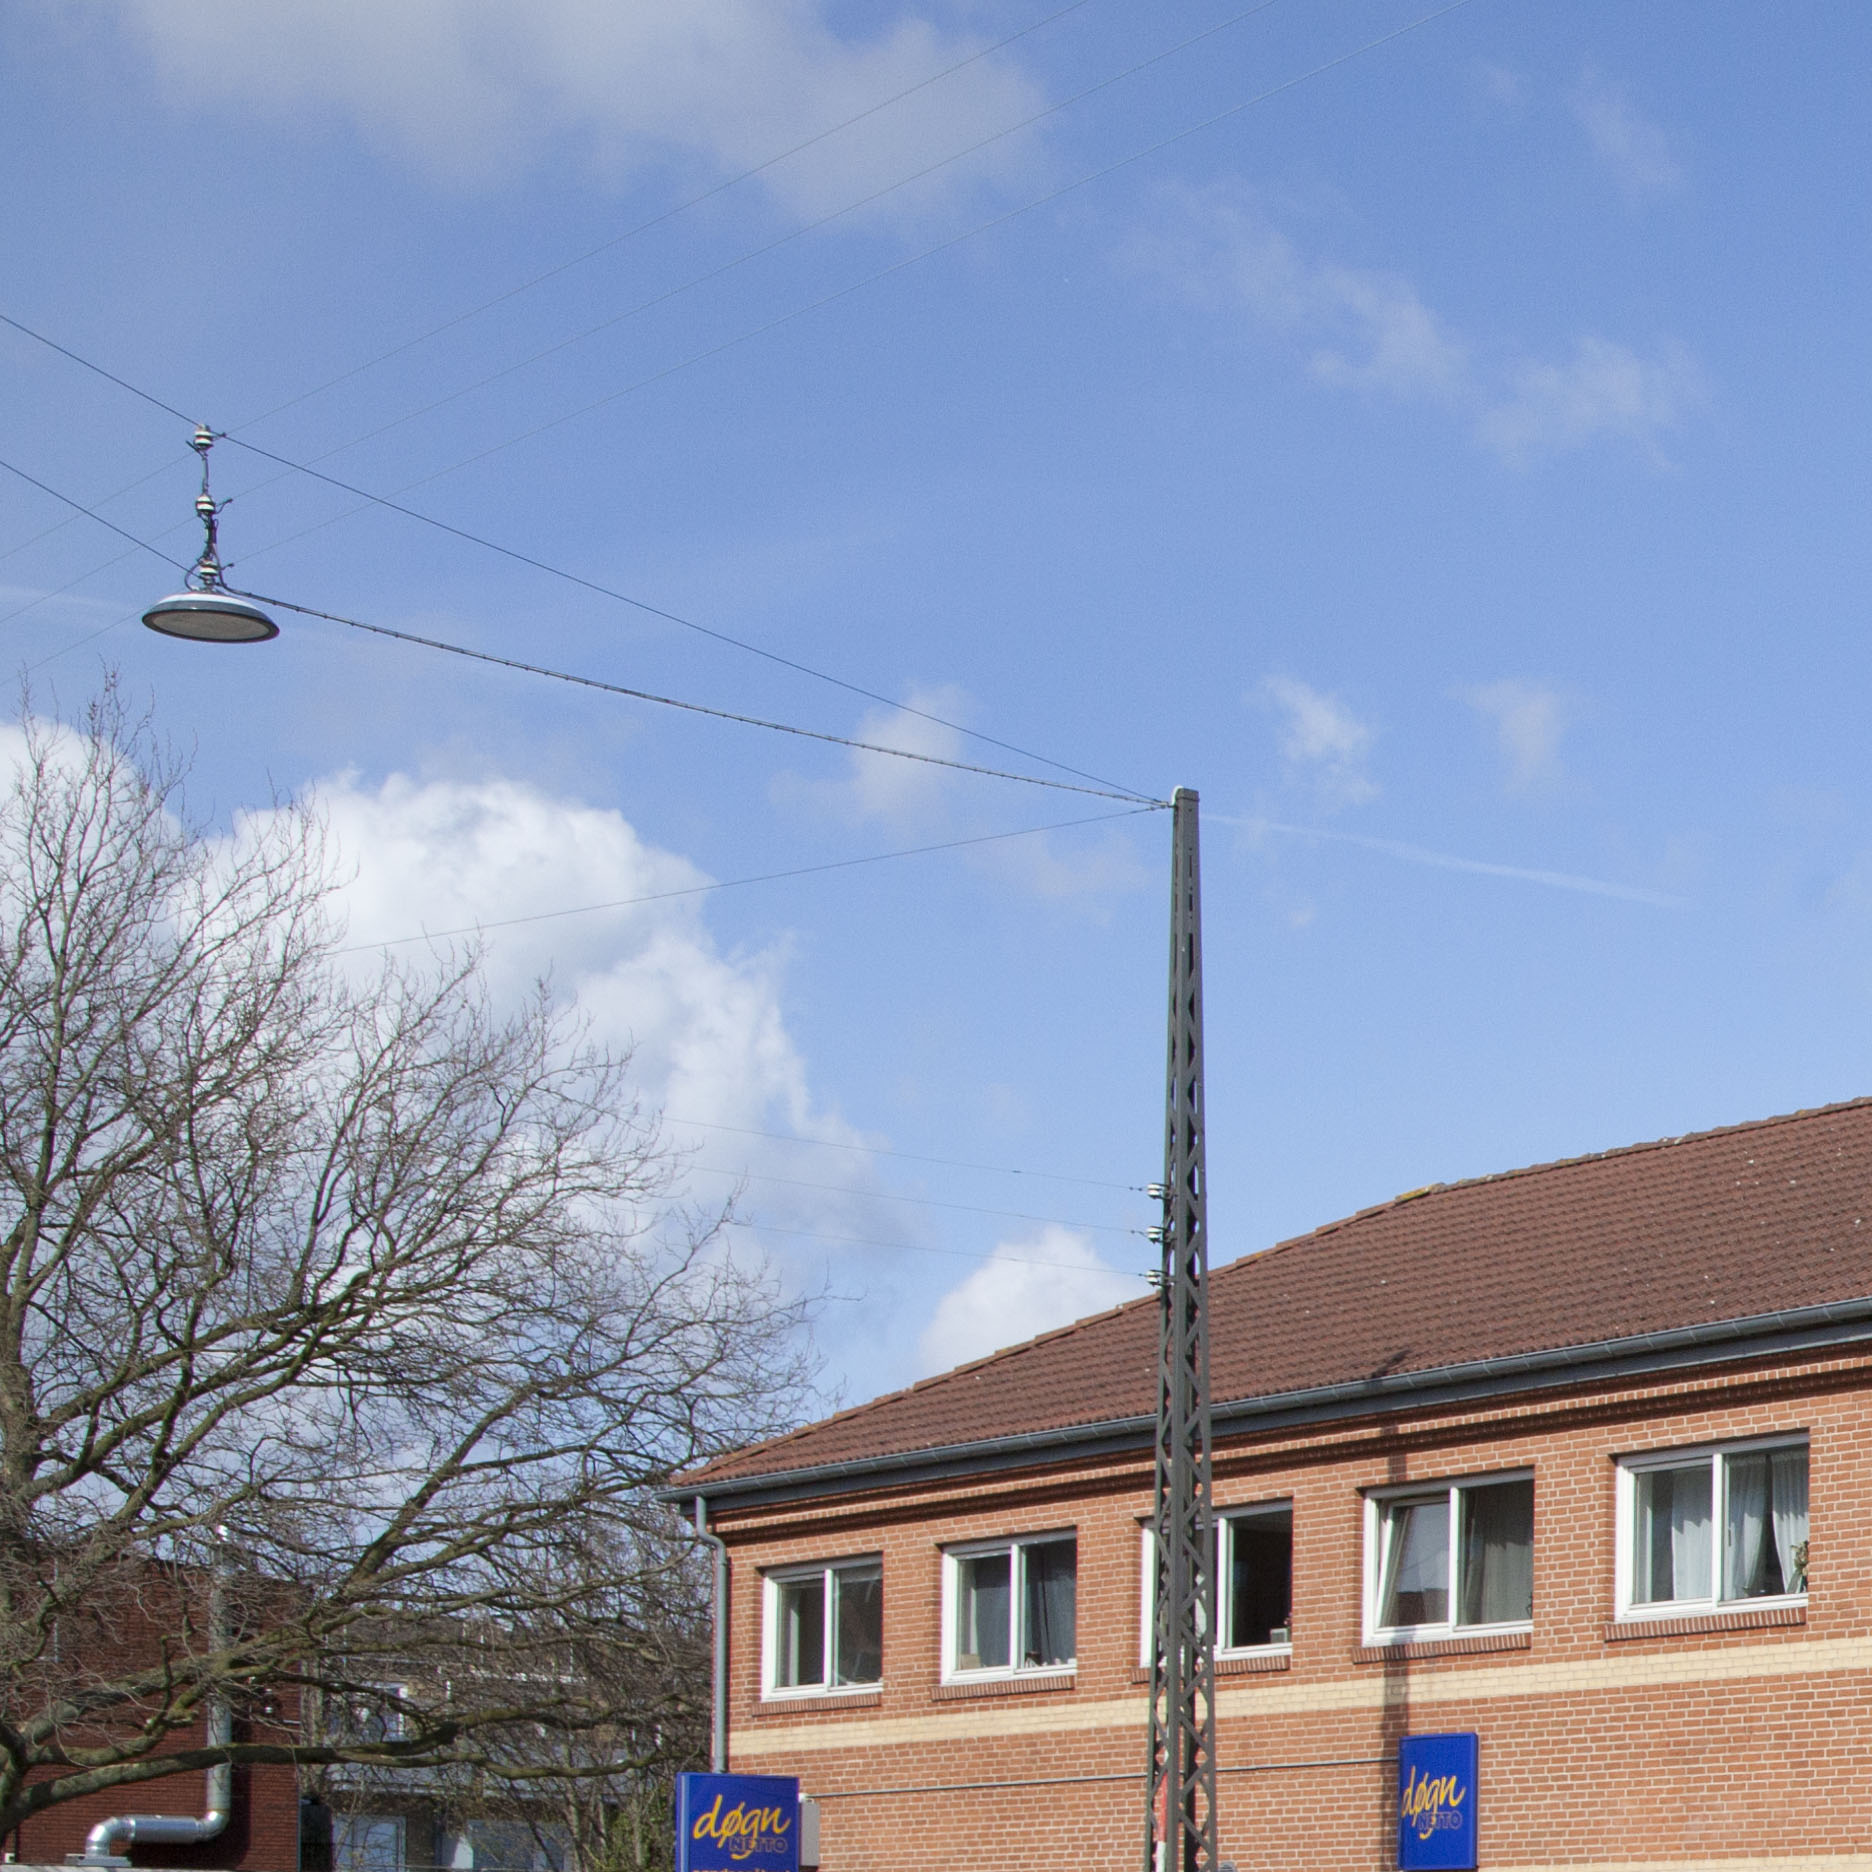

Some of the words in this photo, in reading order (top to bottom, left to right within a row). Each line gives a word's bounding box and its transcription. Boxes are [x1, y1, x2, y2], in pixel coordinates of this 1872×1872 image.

[1401, 1765, 1467, 1840] døgn
[1418, 1809, 1464, 1831] NETTO
[692, 1793, 792, 1860] døgn
[728, 1836, 789, 1854] NETTO
